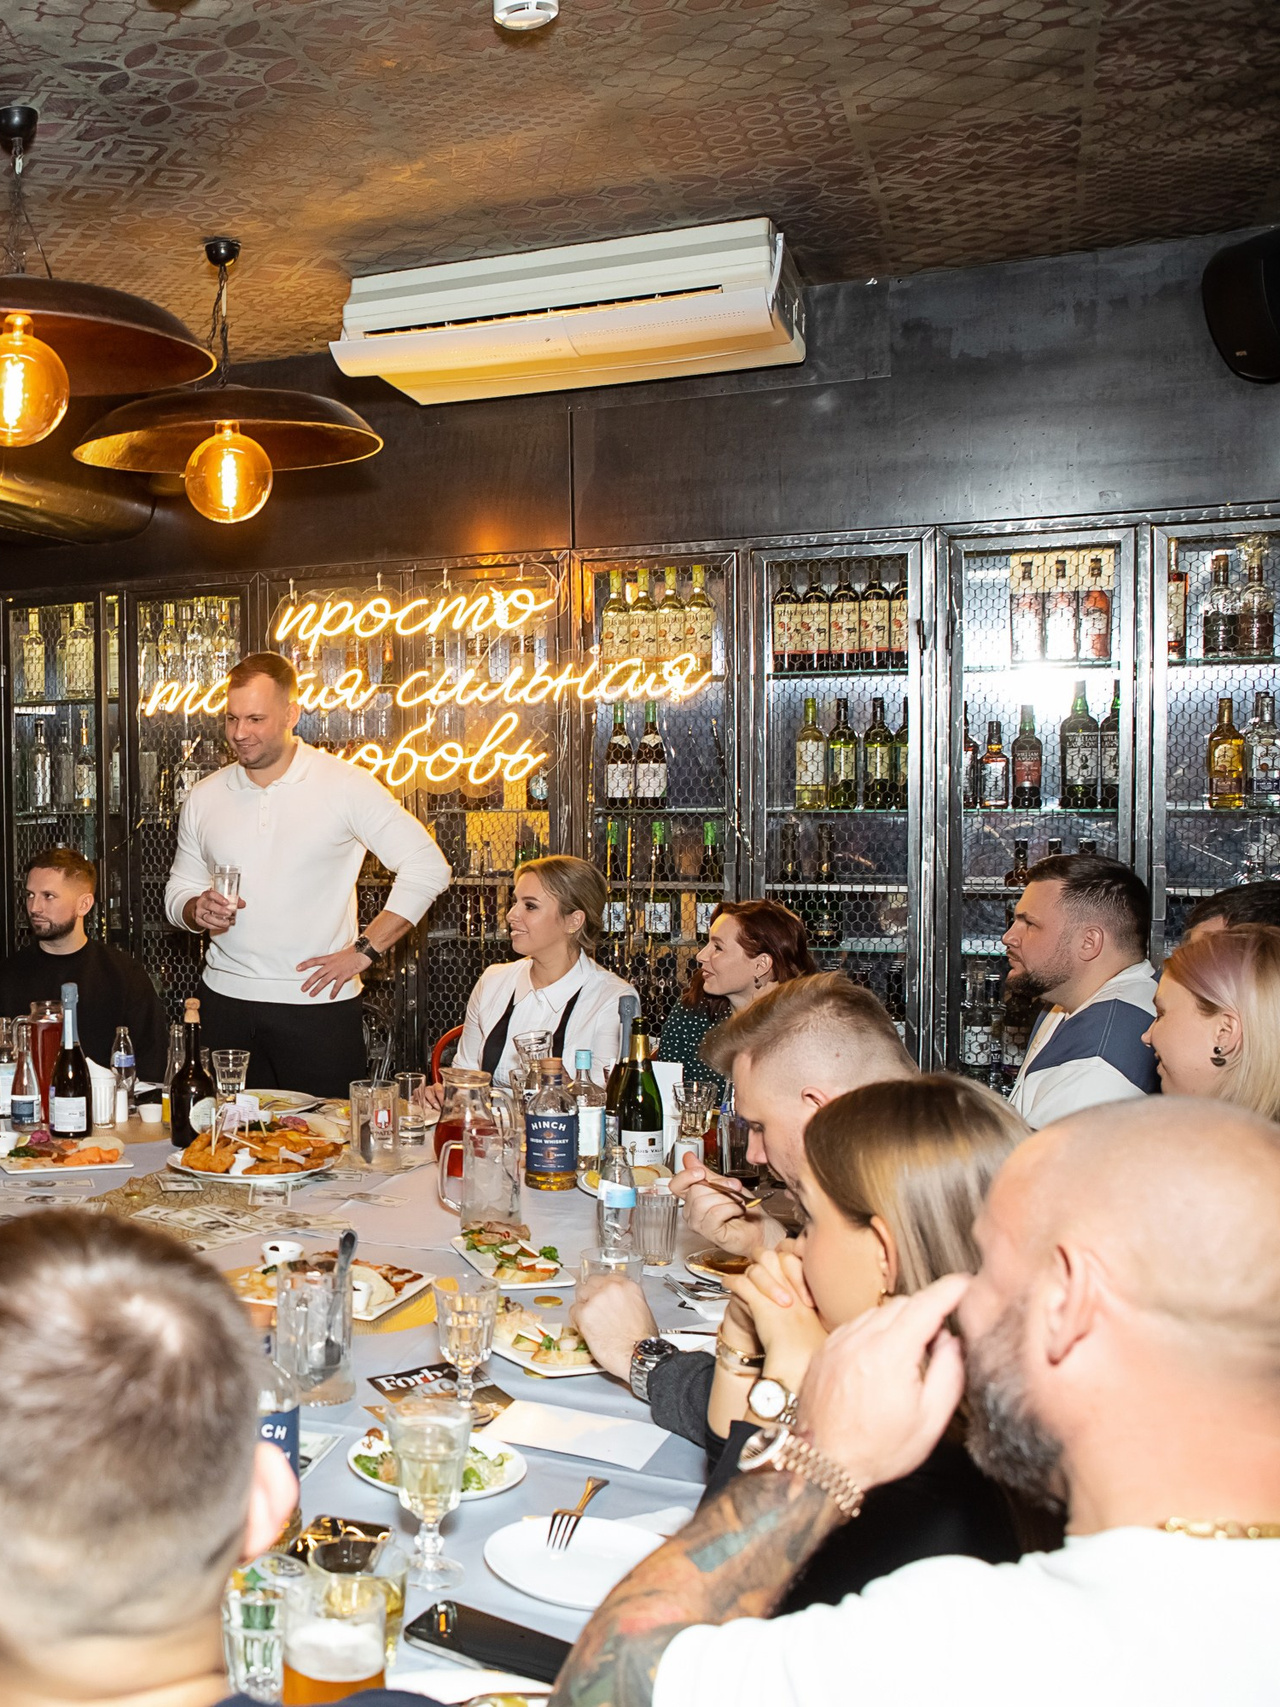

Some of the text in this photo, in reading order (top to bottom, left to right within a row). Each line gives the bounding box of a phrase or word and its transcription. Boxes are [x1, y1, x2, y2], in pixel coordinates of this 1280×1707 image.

[275, 588, 555, 655] просто
[394, 652, 714, 712] сильная
[319, 710, 549, 789] юбовь
[531, 1121, 567, 1131] HINCH
[375, 1368, 444, 1392] Forb
